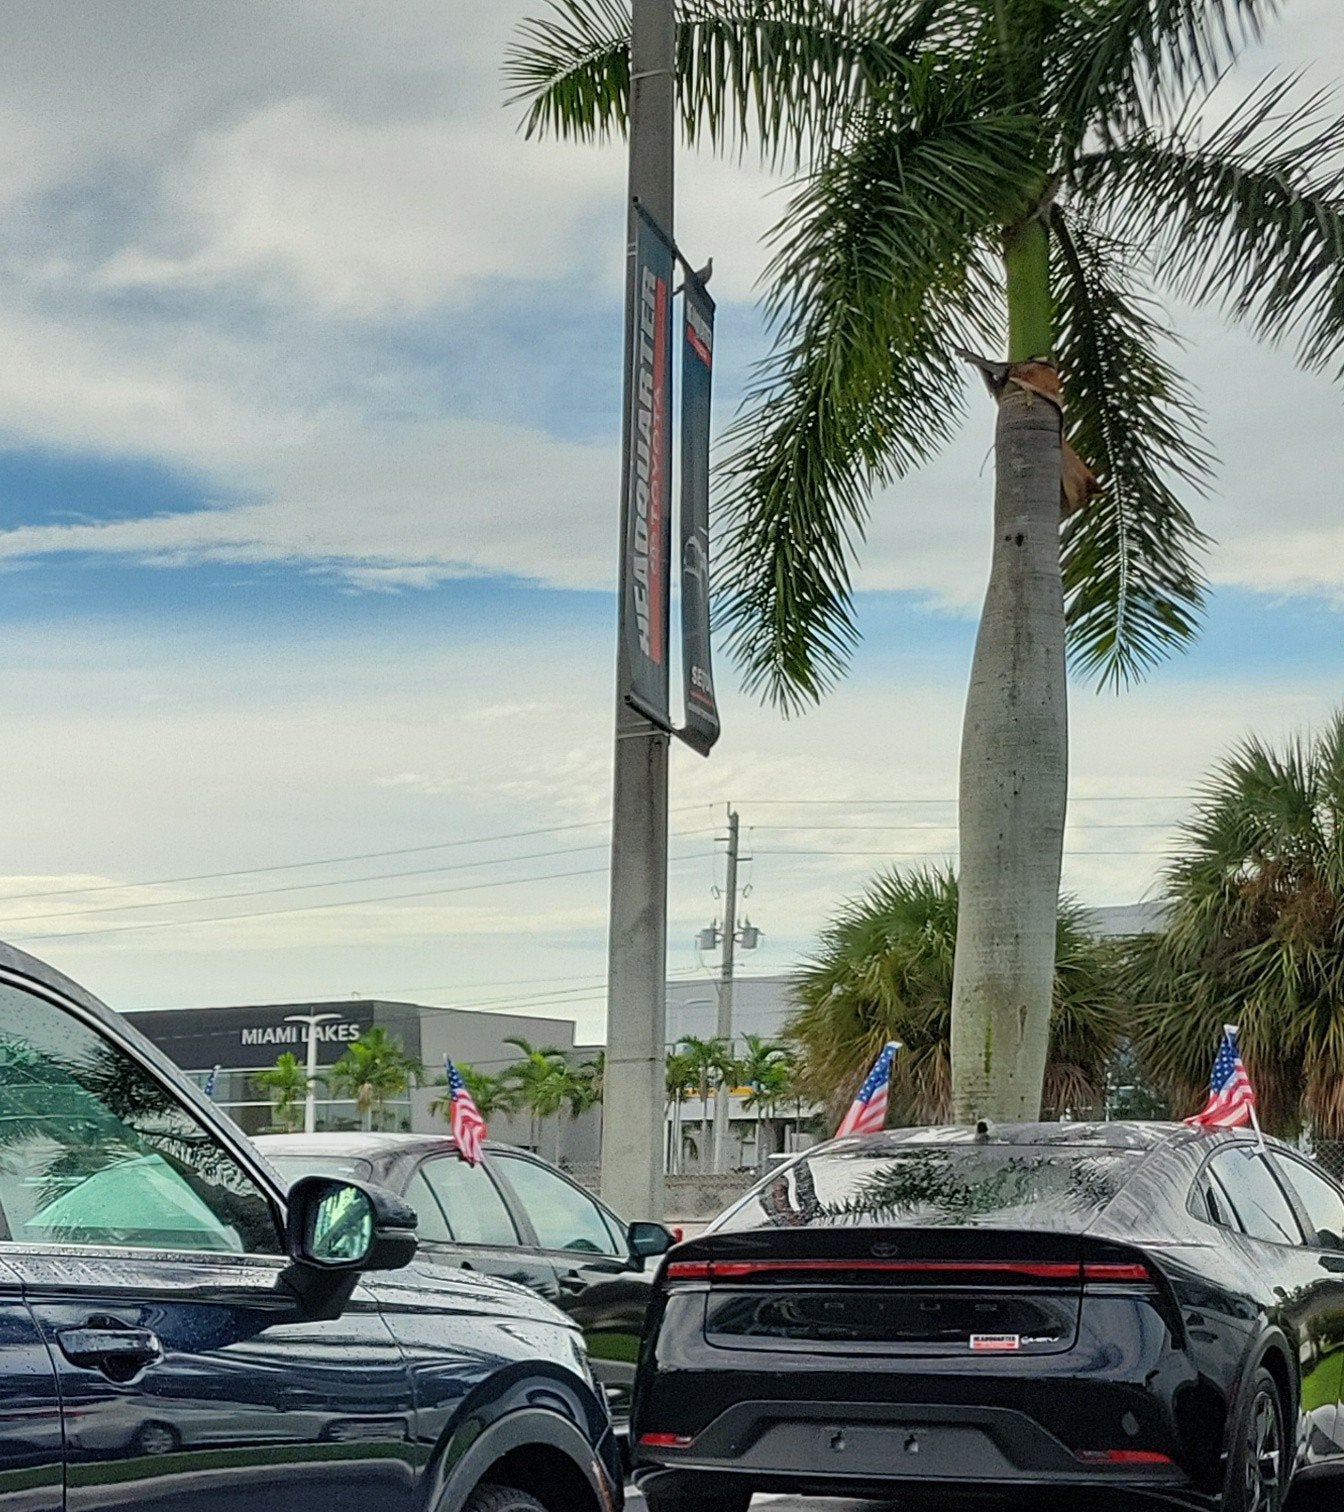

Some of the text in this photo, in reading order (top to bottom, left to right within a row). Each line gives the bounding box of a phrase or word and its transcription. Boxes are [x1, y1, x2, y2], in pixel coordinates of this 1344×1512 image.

[633, 265, 657, 656] HEADQUARTER
[241, 1024, 360, 1045] MIAMI LAKES
